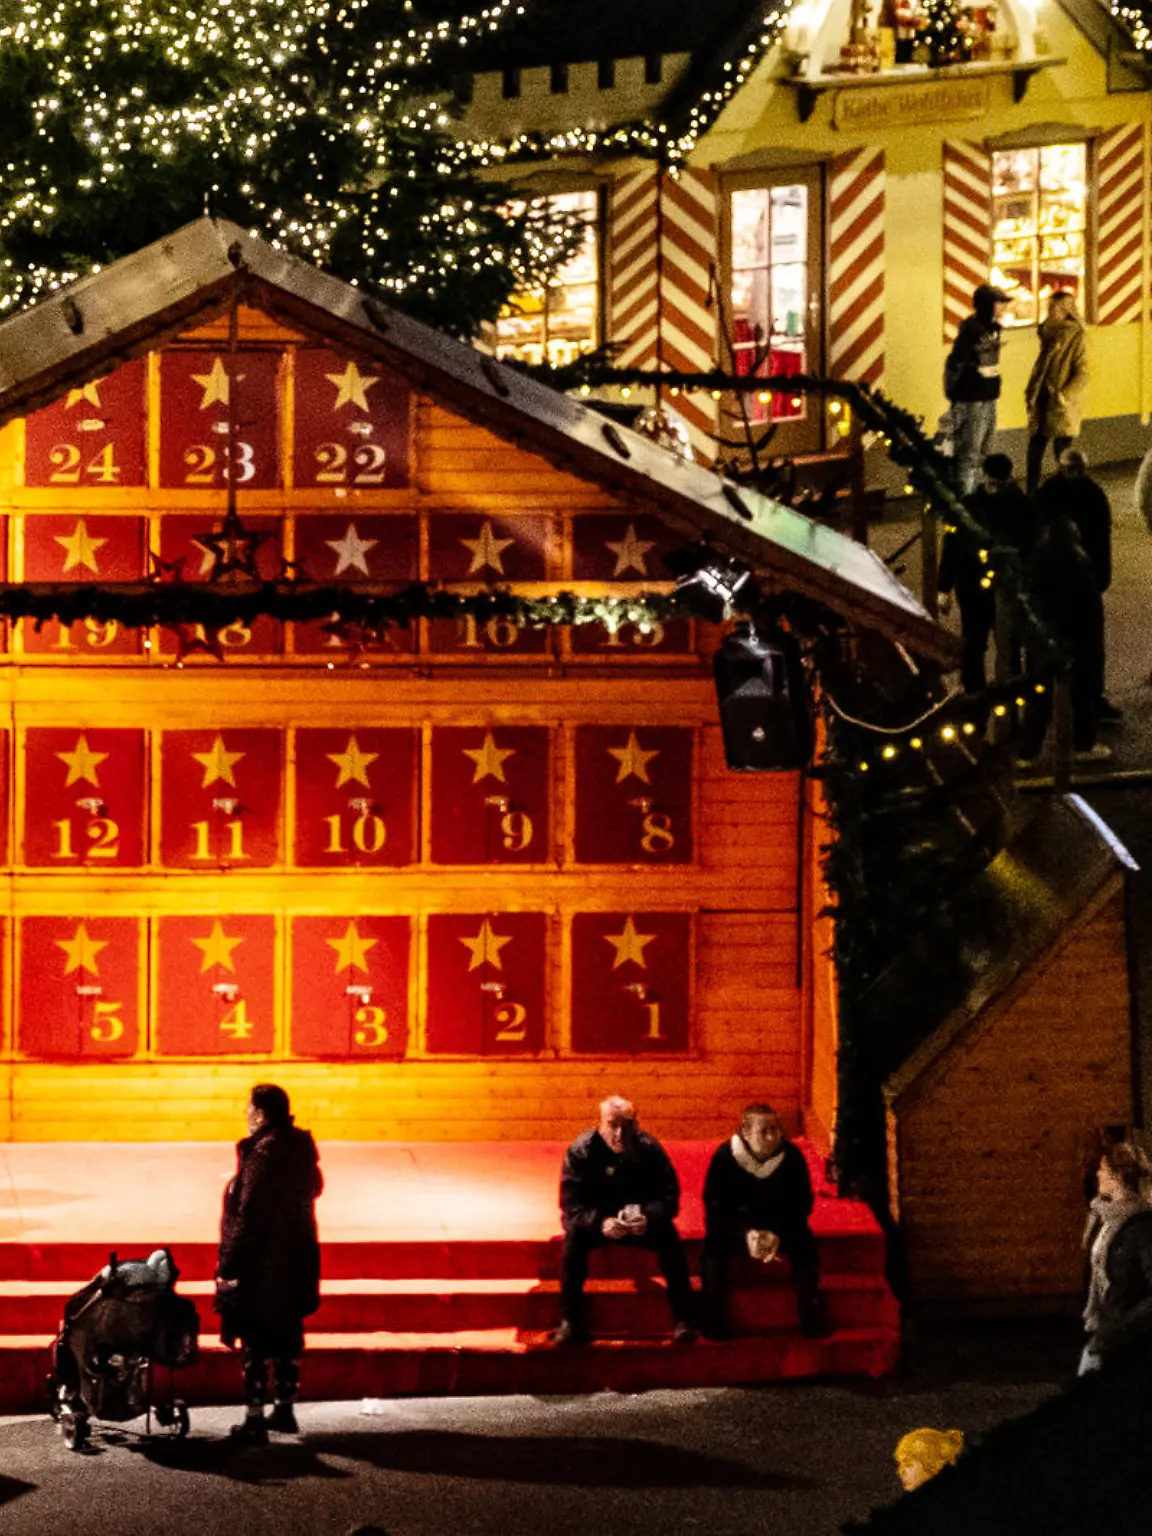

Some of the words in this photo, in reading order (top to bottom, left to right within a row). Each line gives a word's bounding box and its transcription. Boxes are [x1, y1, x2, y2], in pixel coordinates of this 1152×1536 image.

[48, 442, 121, 483] 24
[183, 442, 257, 483] 23
[315, 442, 387, 484] 22
[454, 614, 519, 648] 16
[52, 818, 120, 859] 12
[188, 820, 250, 860] 11
[322, 814, 387, 854] 10
[501, 812, 534, 851] 9
[641, 813, 675, 853] 8
[90, 1002, 124, 1042] 5
[218, 1000, 254, 1040] 4
[354, 1006, 389, 1046] 3
[494, 1002, 528, 1042] 2
[642, 1001, 665, 1040] 1
